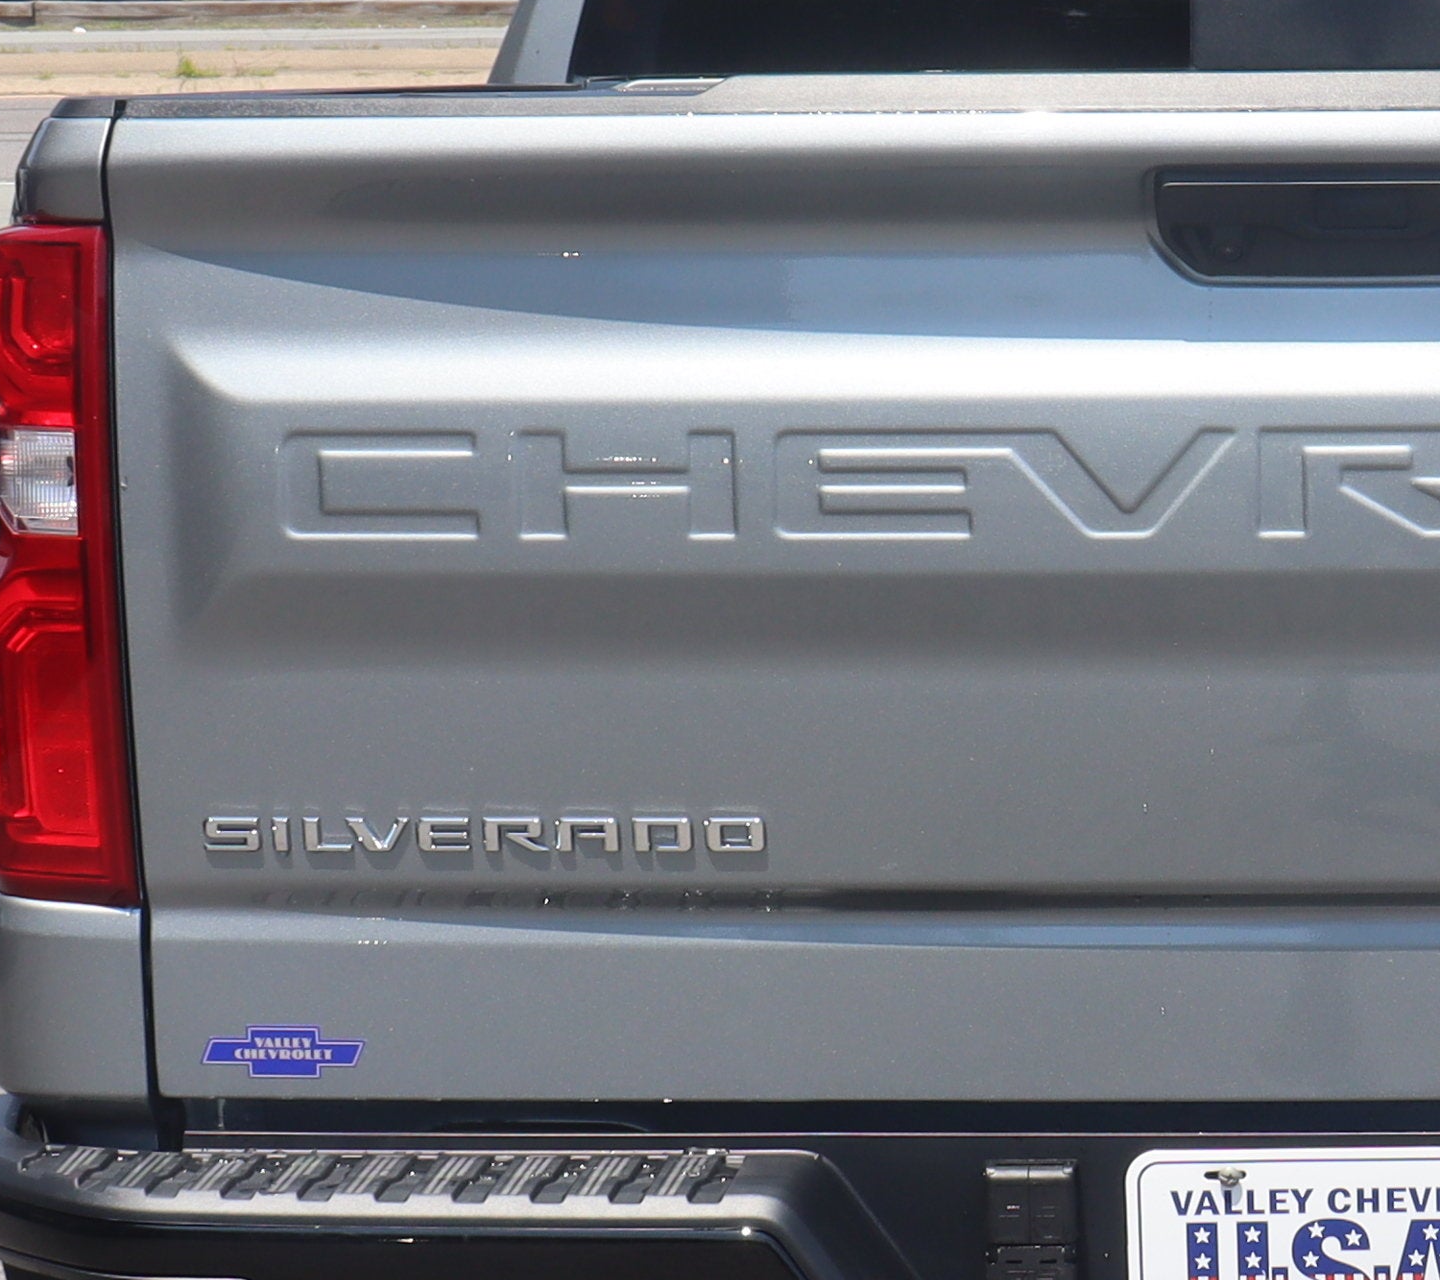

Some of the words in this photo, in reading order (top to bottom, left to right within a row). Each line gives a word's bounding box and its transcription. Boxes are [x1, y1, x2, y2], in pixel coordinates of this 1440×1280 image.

[202, 813, 768, 855] SILVERADO
[254, 1037, 313, 1048] VALLEY
[234, 1048, 333, 1061] CHEVROLET
[1171, 1188, 1314, 1216] VALLEY
